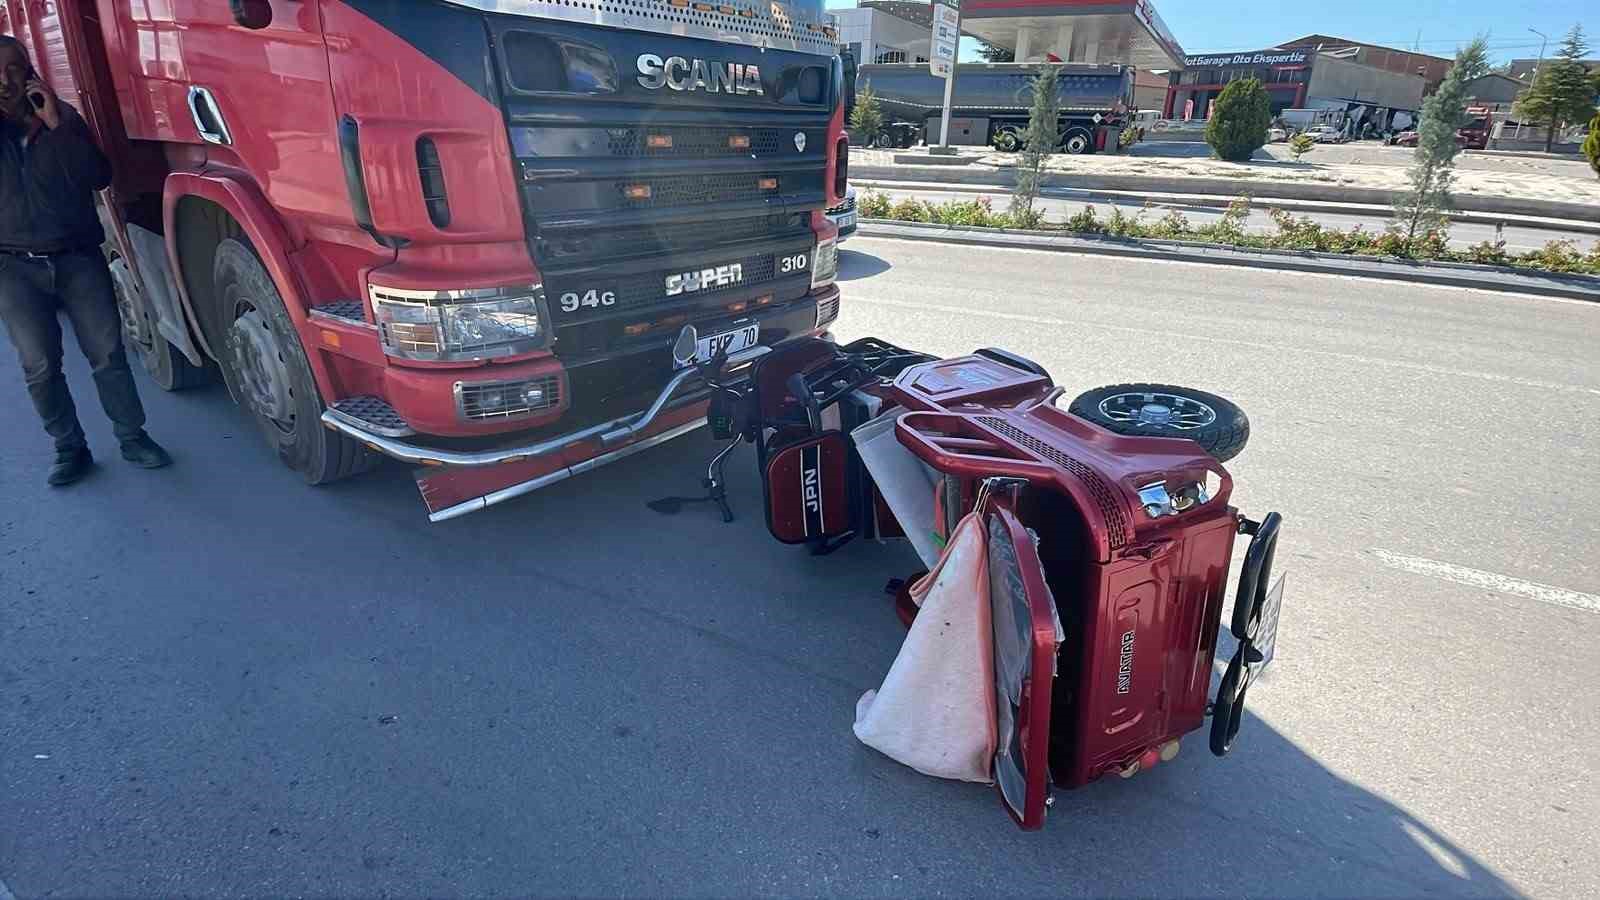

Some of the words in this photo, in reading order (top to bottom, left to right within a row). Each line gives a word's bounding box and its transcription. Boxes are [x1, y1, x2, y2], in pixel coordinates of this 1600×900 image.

[1232, 55, 1251, 64] Oto
[1252, 51, 1305, 65] Ekspertiz
[636, 53, 764, 96] SCANIA
[781, 254, 807, 273] 310
[742, 327, 756, 348] 70
[804, 468, 819, 513] JPN
[1117, 630, 1137, 695] AVATAR
